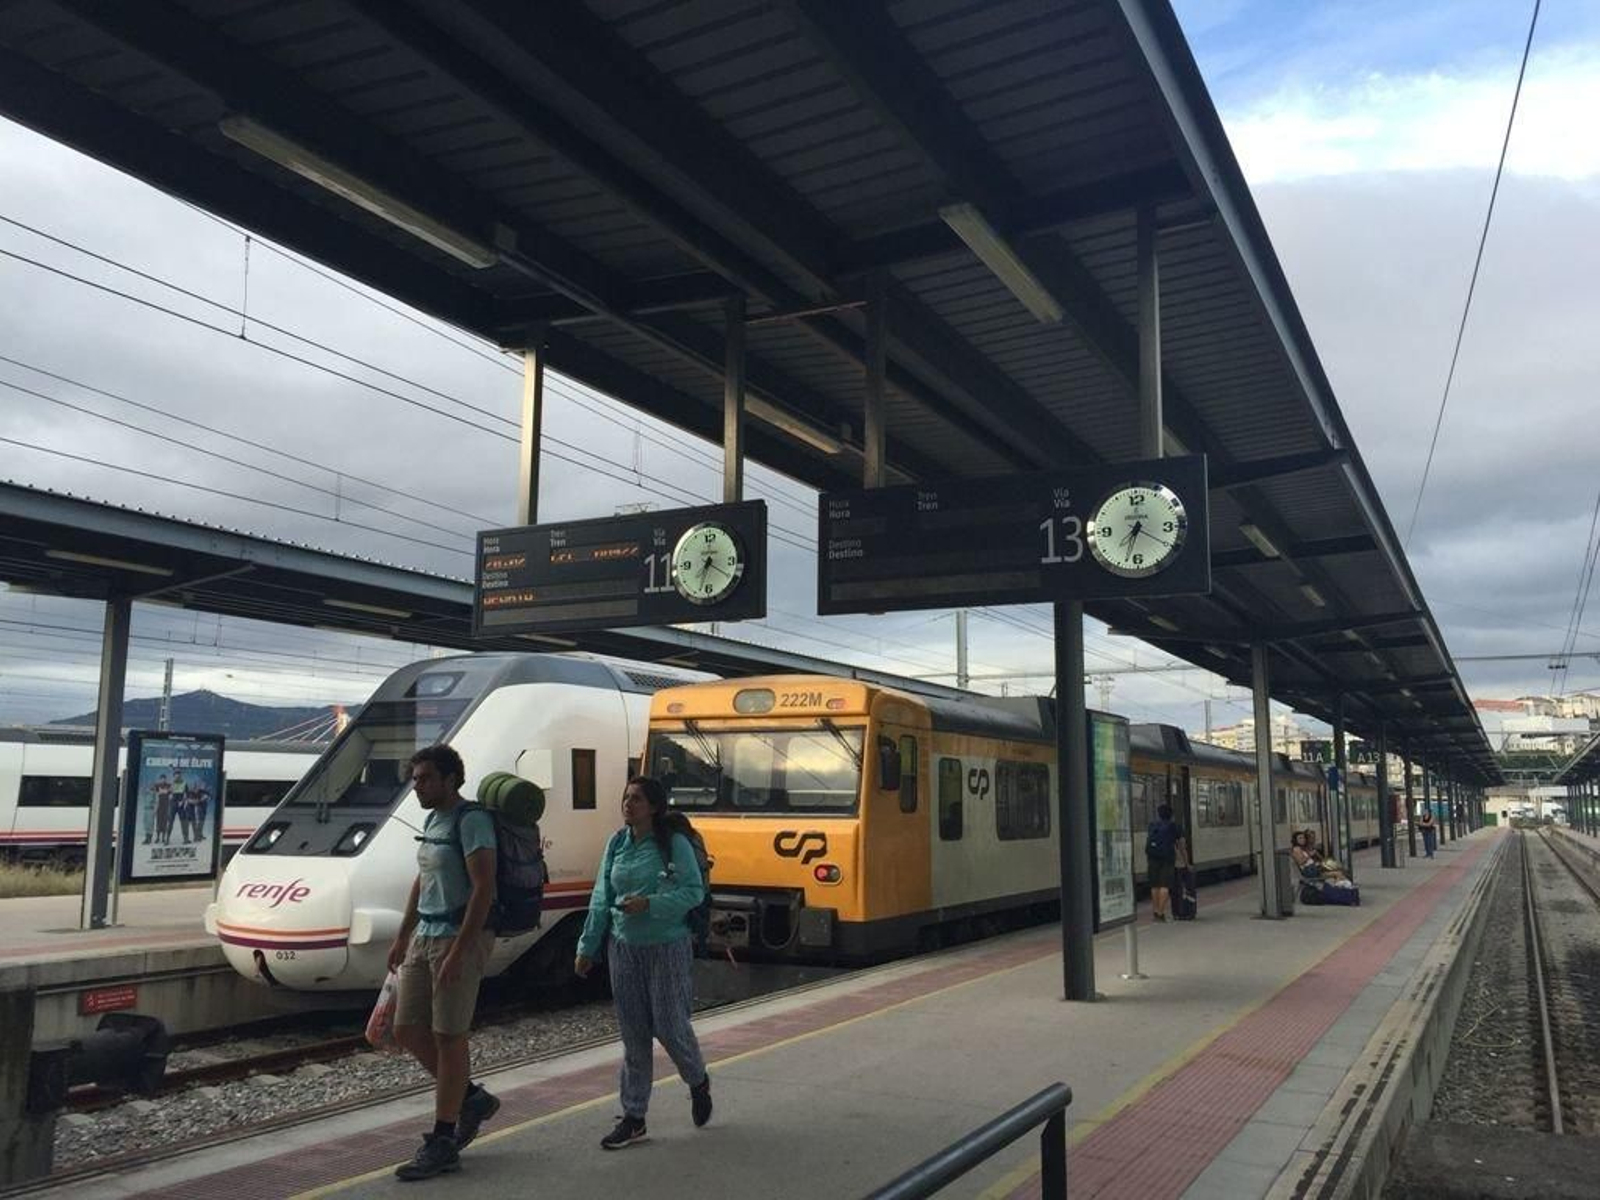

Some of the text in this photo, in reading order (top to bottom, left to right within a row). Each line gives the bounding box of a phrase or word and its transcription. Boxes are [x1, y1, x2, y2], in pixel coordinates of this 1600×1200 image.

[916, 500, 938, 511] Tren
[1128, 494, 1145, 506] 12
[1101, 521, 1174, 538] 9 3
[704, 533, 717, 544] 12
[1039, 516, 1084, 564] 13
[828, 548, 863, 559] Destino
[1132, 553, 1144, 565] 6
[683, 556, 735, 570] 9 3
[643, 552, 676, 594] 11
[705, 584, 713, 594] 6
[780, 692, 822, 708] 222M
[236, 877, 311, 908] renfe
[276, 950, 296, 961] 032
